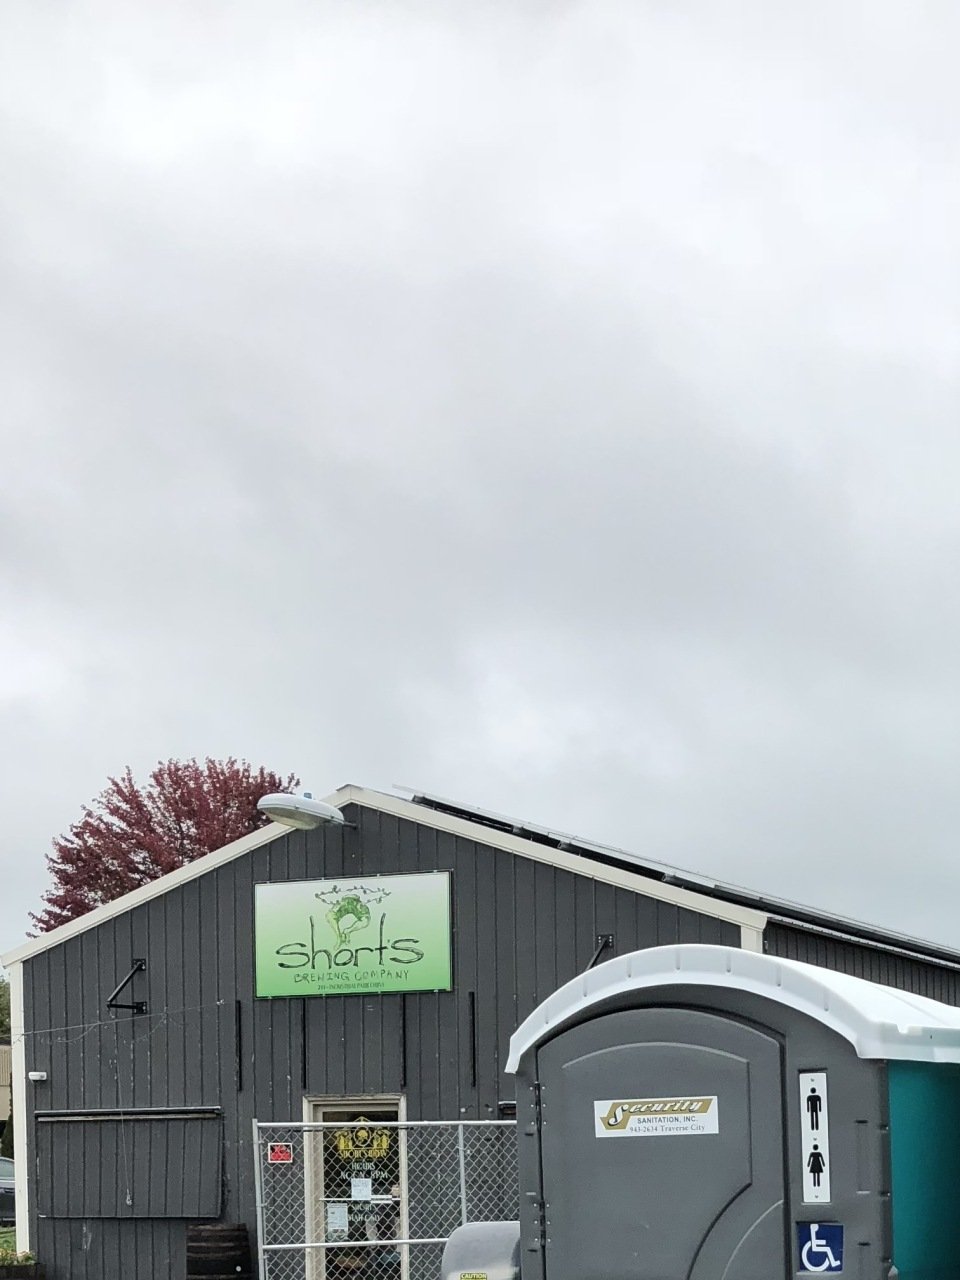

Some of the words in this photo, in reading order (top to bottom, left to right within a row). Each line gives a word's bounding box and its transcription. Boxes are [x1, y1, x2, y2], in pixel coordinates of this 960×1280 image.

[294, 971, 350, 984] BREWING
[354, 969, 409, 982] COMPANY
[607, 1100, 704, 1127] Security
[637, 1116, 682, 1124] SANITATION,
[660, 1124, 688, 1132] Traverse
[690, 1124, 705, 1132] City
